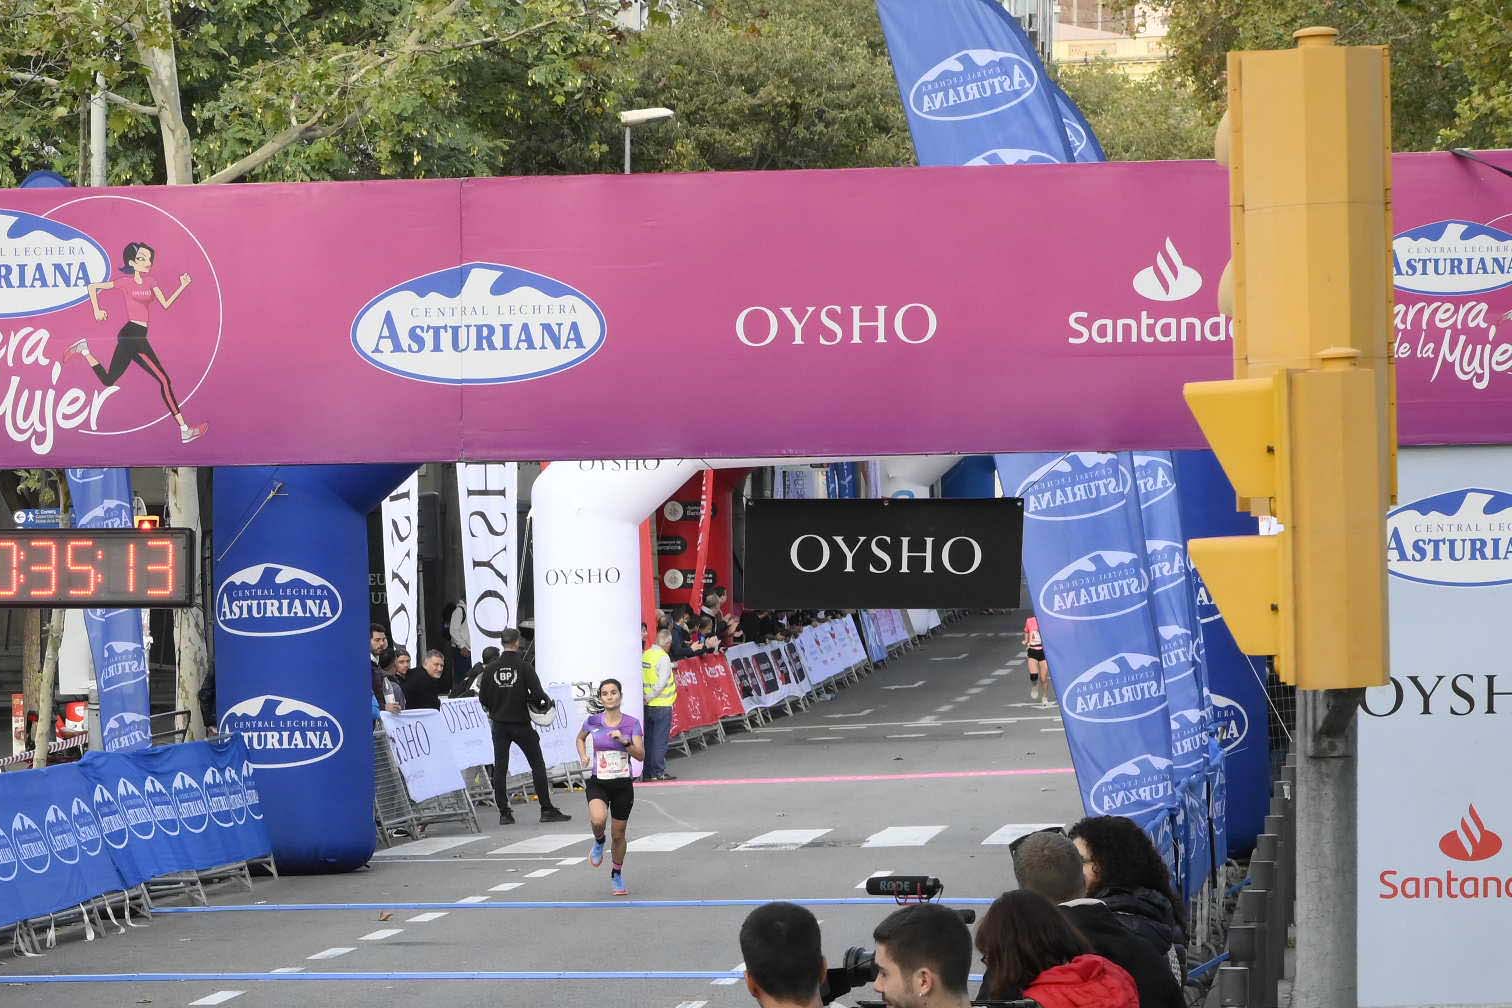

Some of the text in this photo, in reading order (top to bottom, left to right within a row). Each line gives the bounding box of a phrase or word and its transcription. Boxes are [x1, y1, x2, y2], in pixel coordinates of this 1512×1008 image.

[14, 245, 86, 256] LECHERA
[1464, 245, 1512, 253] LECHER
[411, 303, 578, 318] CENTRAL LECHERA
[1393, 301, 1489, 330] arrera
[371, 309, 586, 355] ASTURIANA
[735, 303, 938, 348] OYSHO
[1068, 310, 1234, 345] Santand
[1417, 331, 1435, 358] la
[1430, 325, 1512, 390] Muje
[1414, 522, 1482, 533] CENTRAL
[790, 534, 983, 575] OYSHO
[1386, 526, 1512, 563] ASTURI
[545, 566, 621, 587] OYSHO
[233, 588, 329, 597] CENTRAL LECHERA
[220, 593, 333, 621] ASTURIANA
[223, 727, 333, 750] TURIANA
[1379, 870, 1512, 900] Santan
